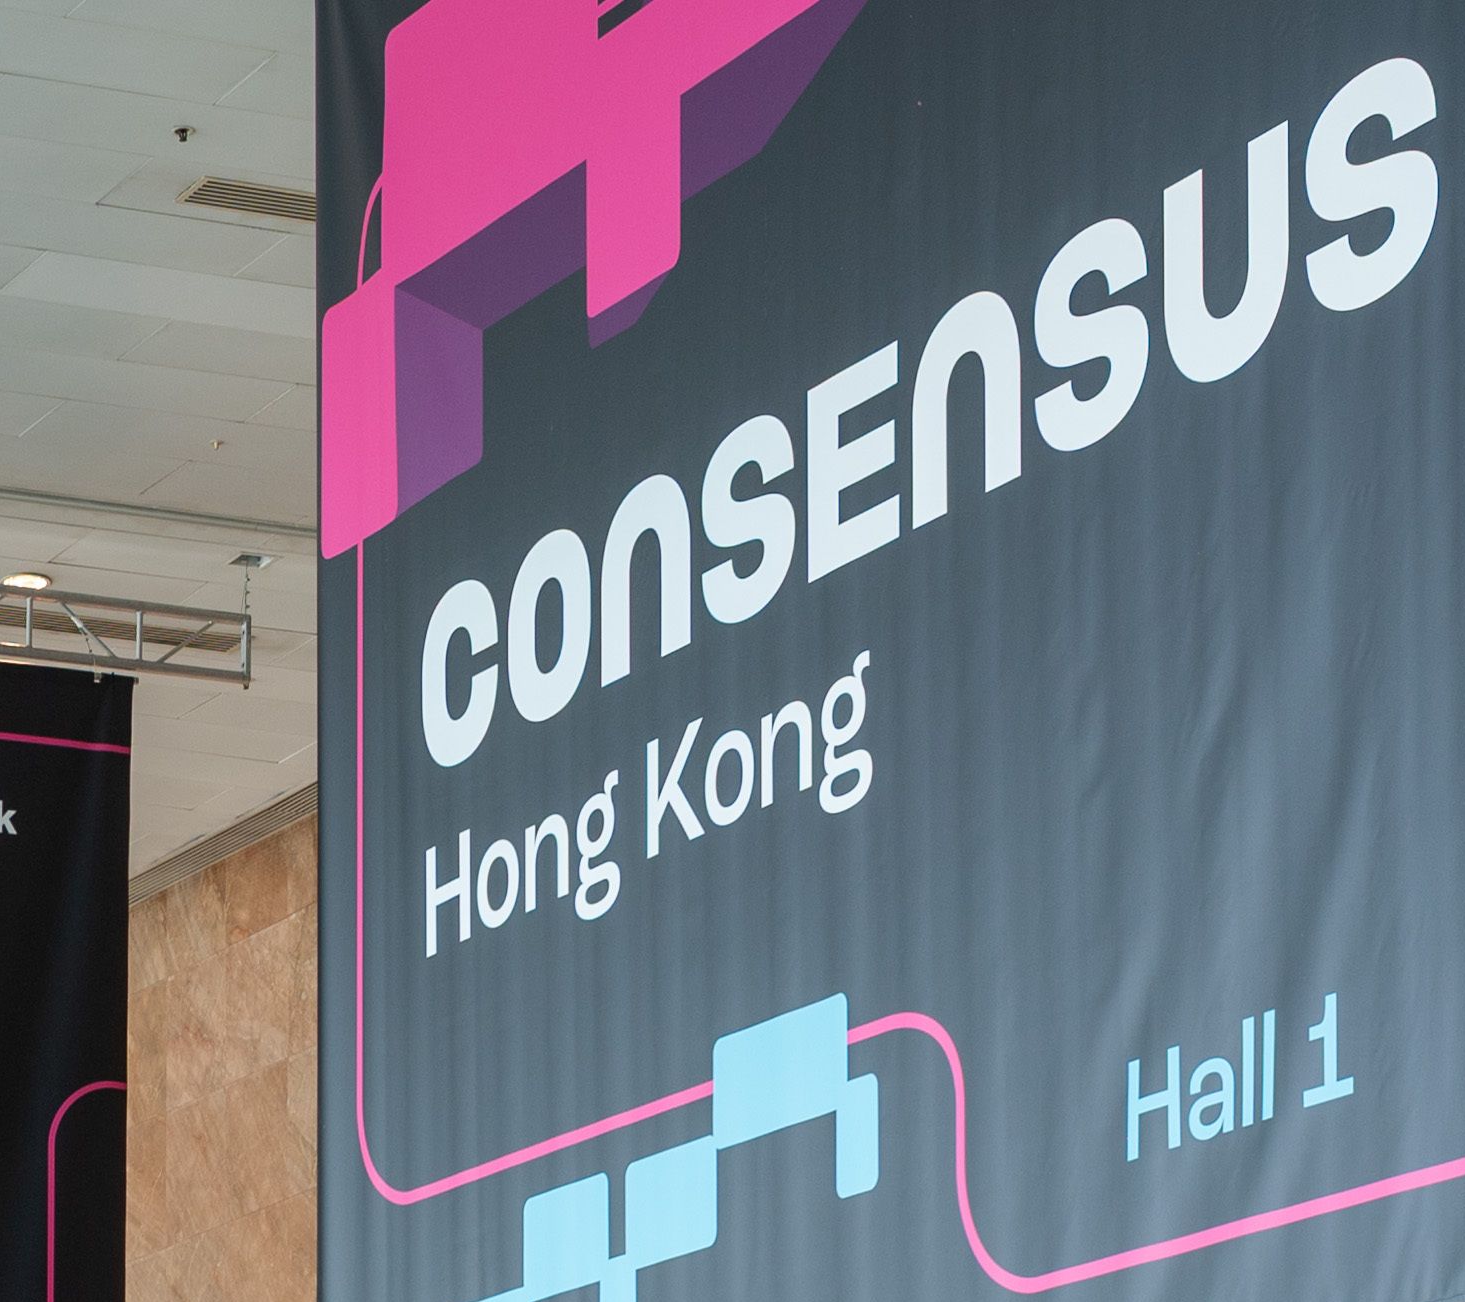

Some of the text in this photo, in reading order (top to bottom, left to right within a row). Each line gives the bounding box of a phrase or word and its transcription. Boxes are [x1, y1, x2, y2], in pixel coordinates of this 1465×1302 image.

[420, 56, 1438, 766] CONSENSUS
[425, 650, 872, 958] Hong Kong
[1126, 993, 1355, 1161] Hall 1
